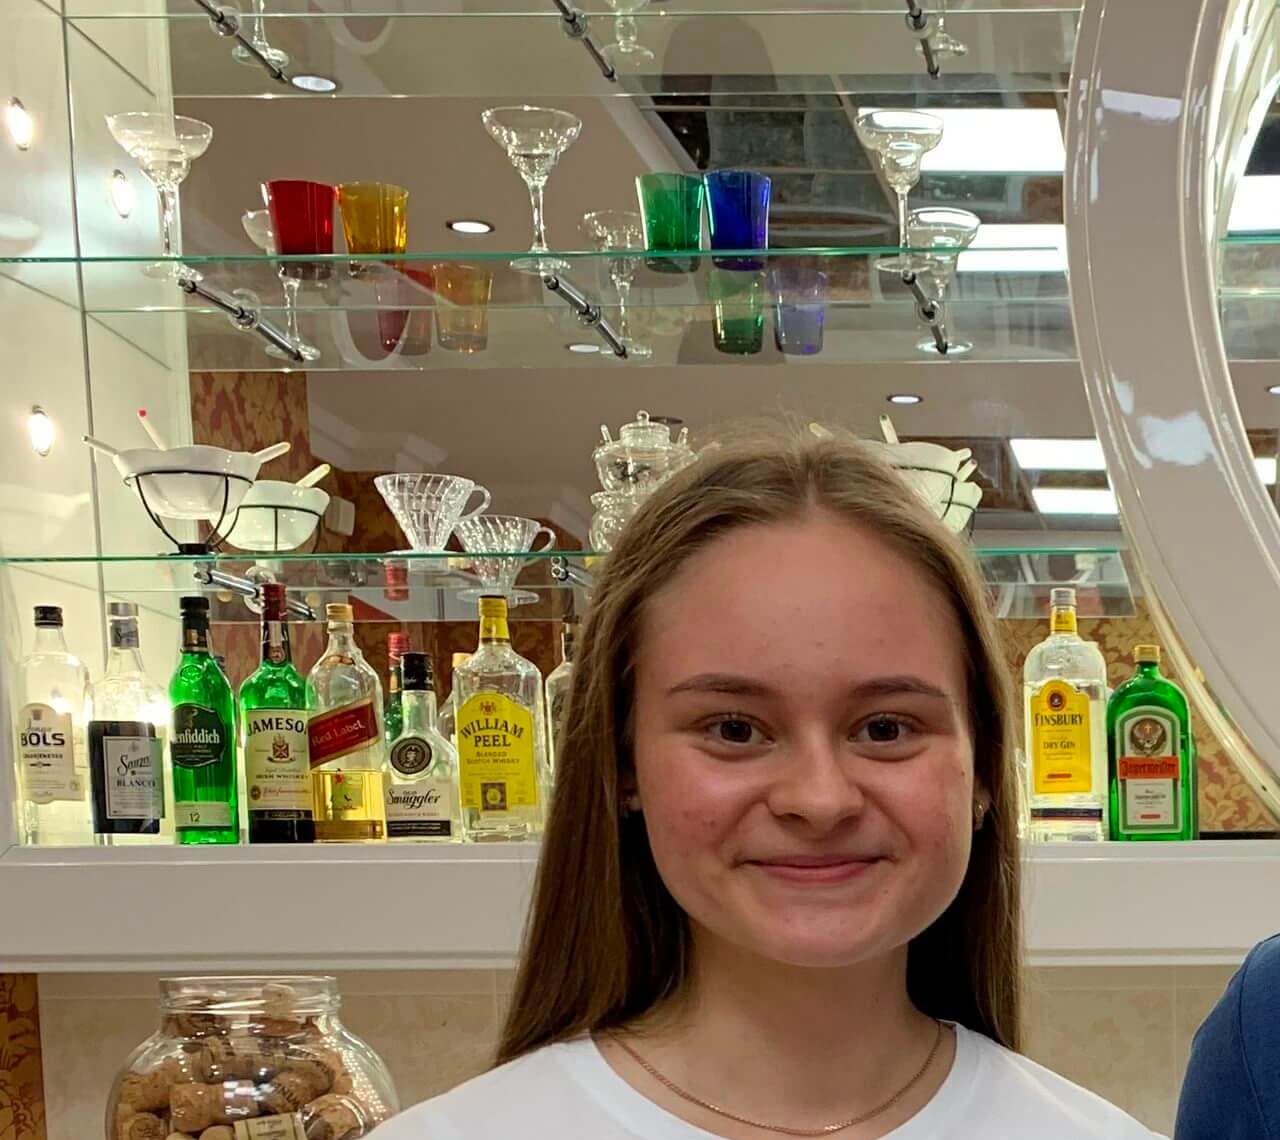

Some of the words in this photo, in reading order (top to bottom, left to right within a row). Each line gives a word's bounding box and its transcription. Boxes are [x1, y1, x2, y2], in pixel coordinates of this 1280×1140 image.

[1035, 713, 1083, 727] FINSBURY
[334, 720, 365, 737] Label
[460, 718, 524, 738] WILLIAM
[21, 732, 65, 746] BOLS
[474, 735, 511, 747] PEEL
[387, 788, 440, 809] Smuggler
[189, 813, 200, 823] 12
